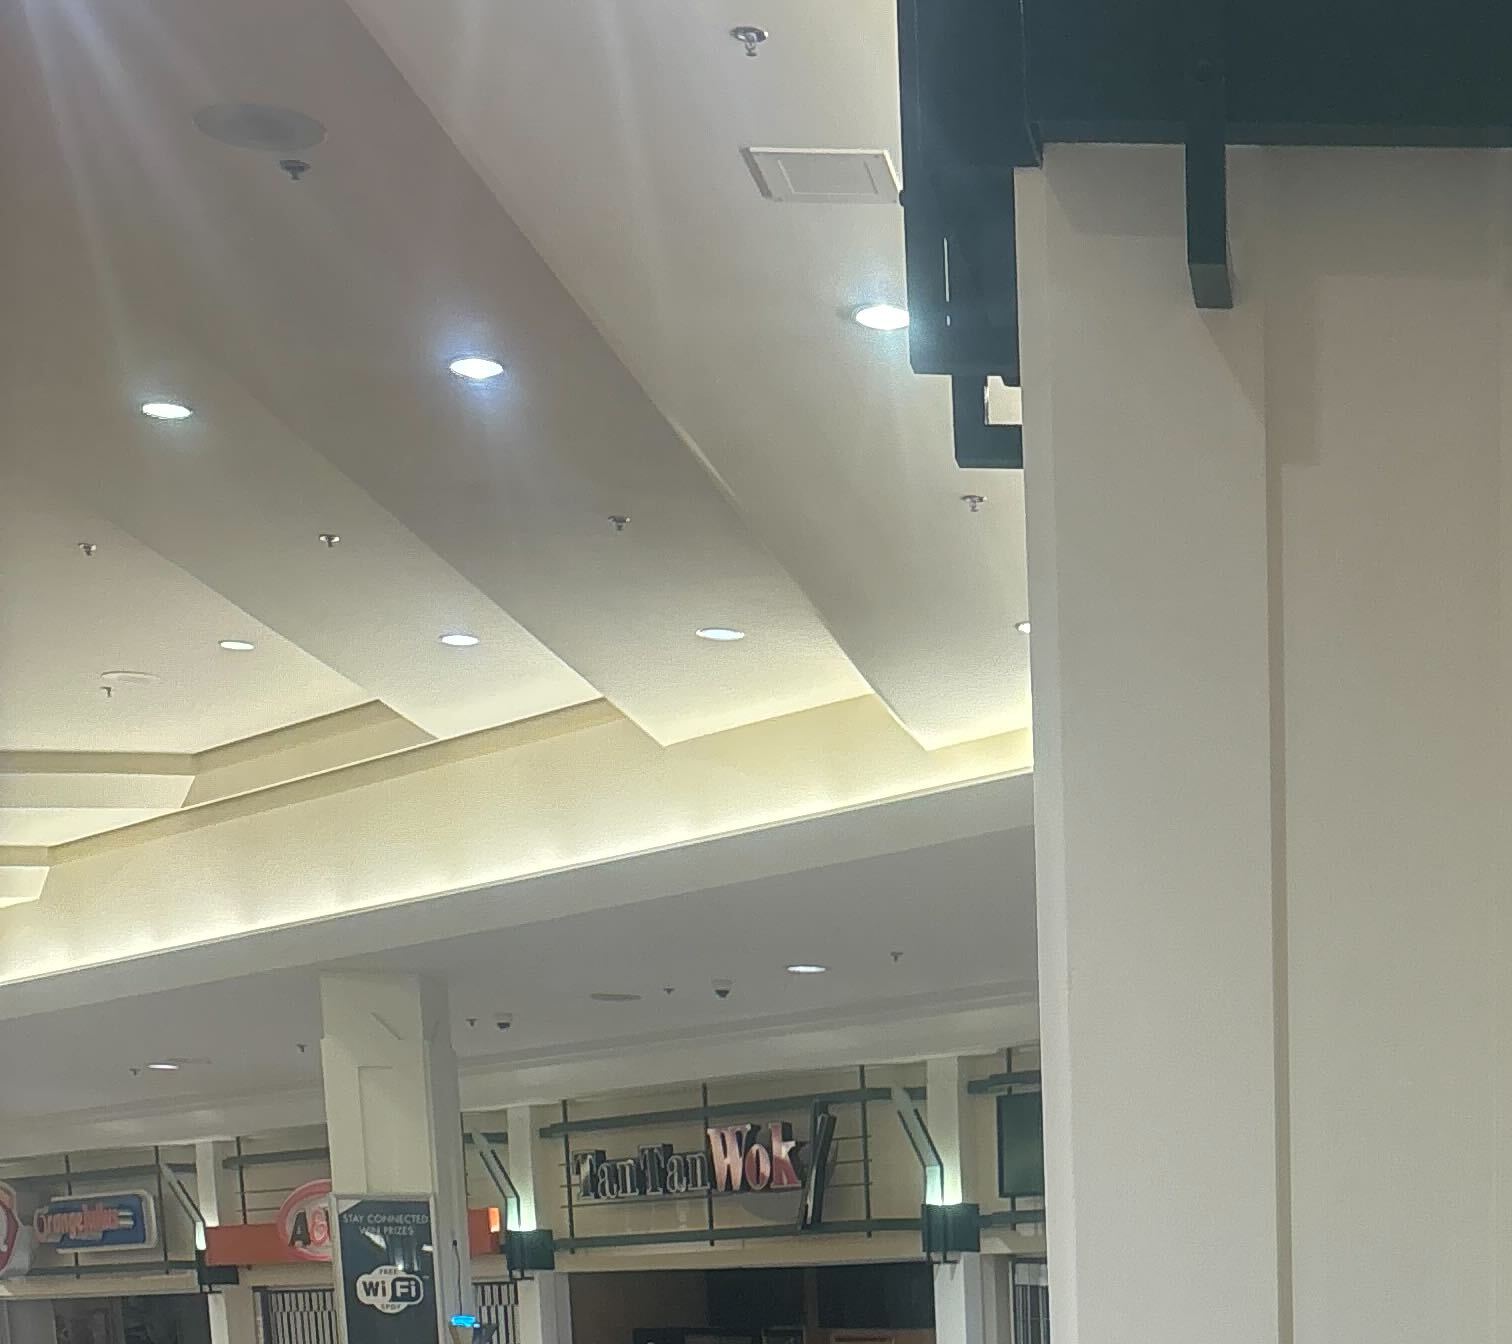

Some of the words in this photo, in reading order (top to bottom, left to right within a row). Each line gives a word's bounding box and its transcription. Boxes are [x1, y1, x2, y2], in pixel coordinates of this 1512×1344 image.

[343, 1213, 364, 1223] STAY
[367, 1213, 429, 1224] CONNECTED
[383, 1225, 414, 1235] PRIZES
